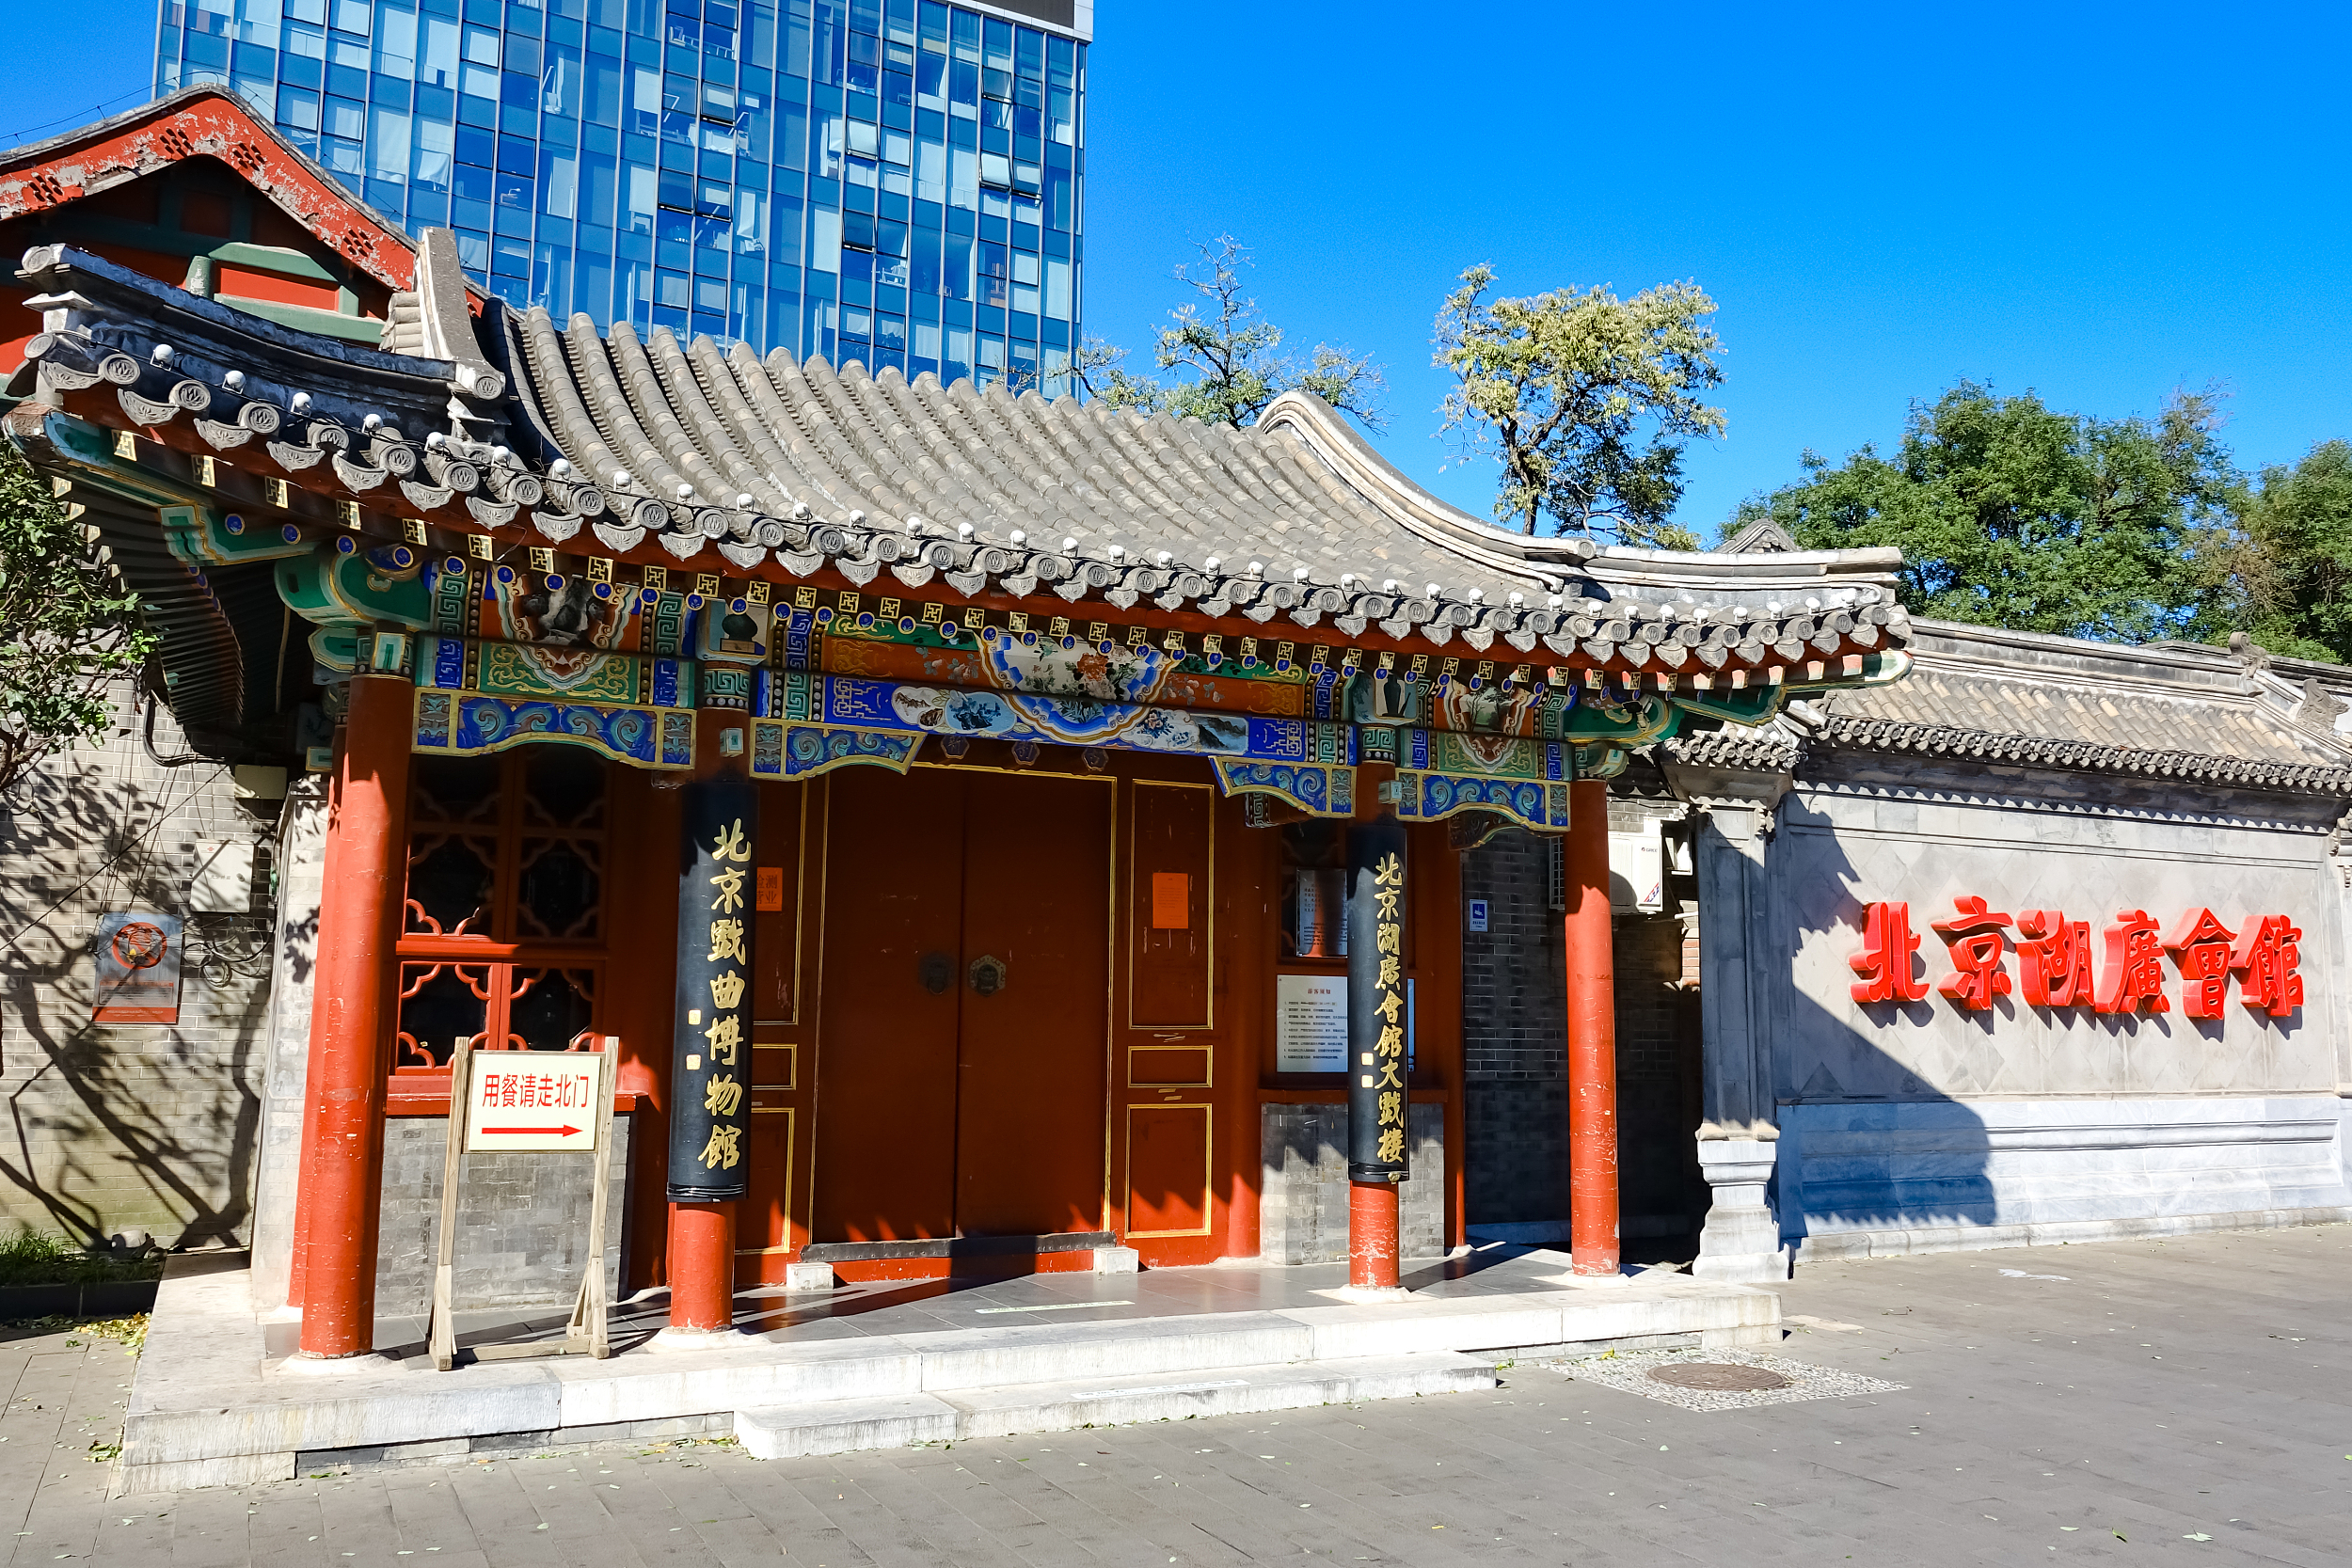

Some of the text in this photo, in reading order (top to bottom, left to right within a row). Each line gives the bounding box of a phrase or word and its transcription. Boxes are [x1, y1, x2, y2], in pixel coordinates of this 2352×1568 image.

[1849, 895, 2305, 1022] 北京湖廣會館
[482, 1072, 589, 1109] 用餐请走北门
